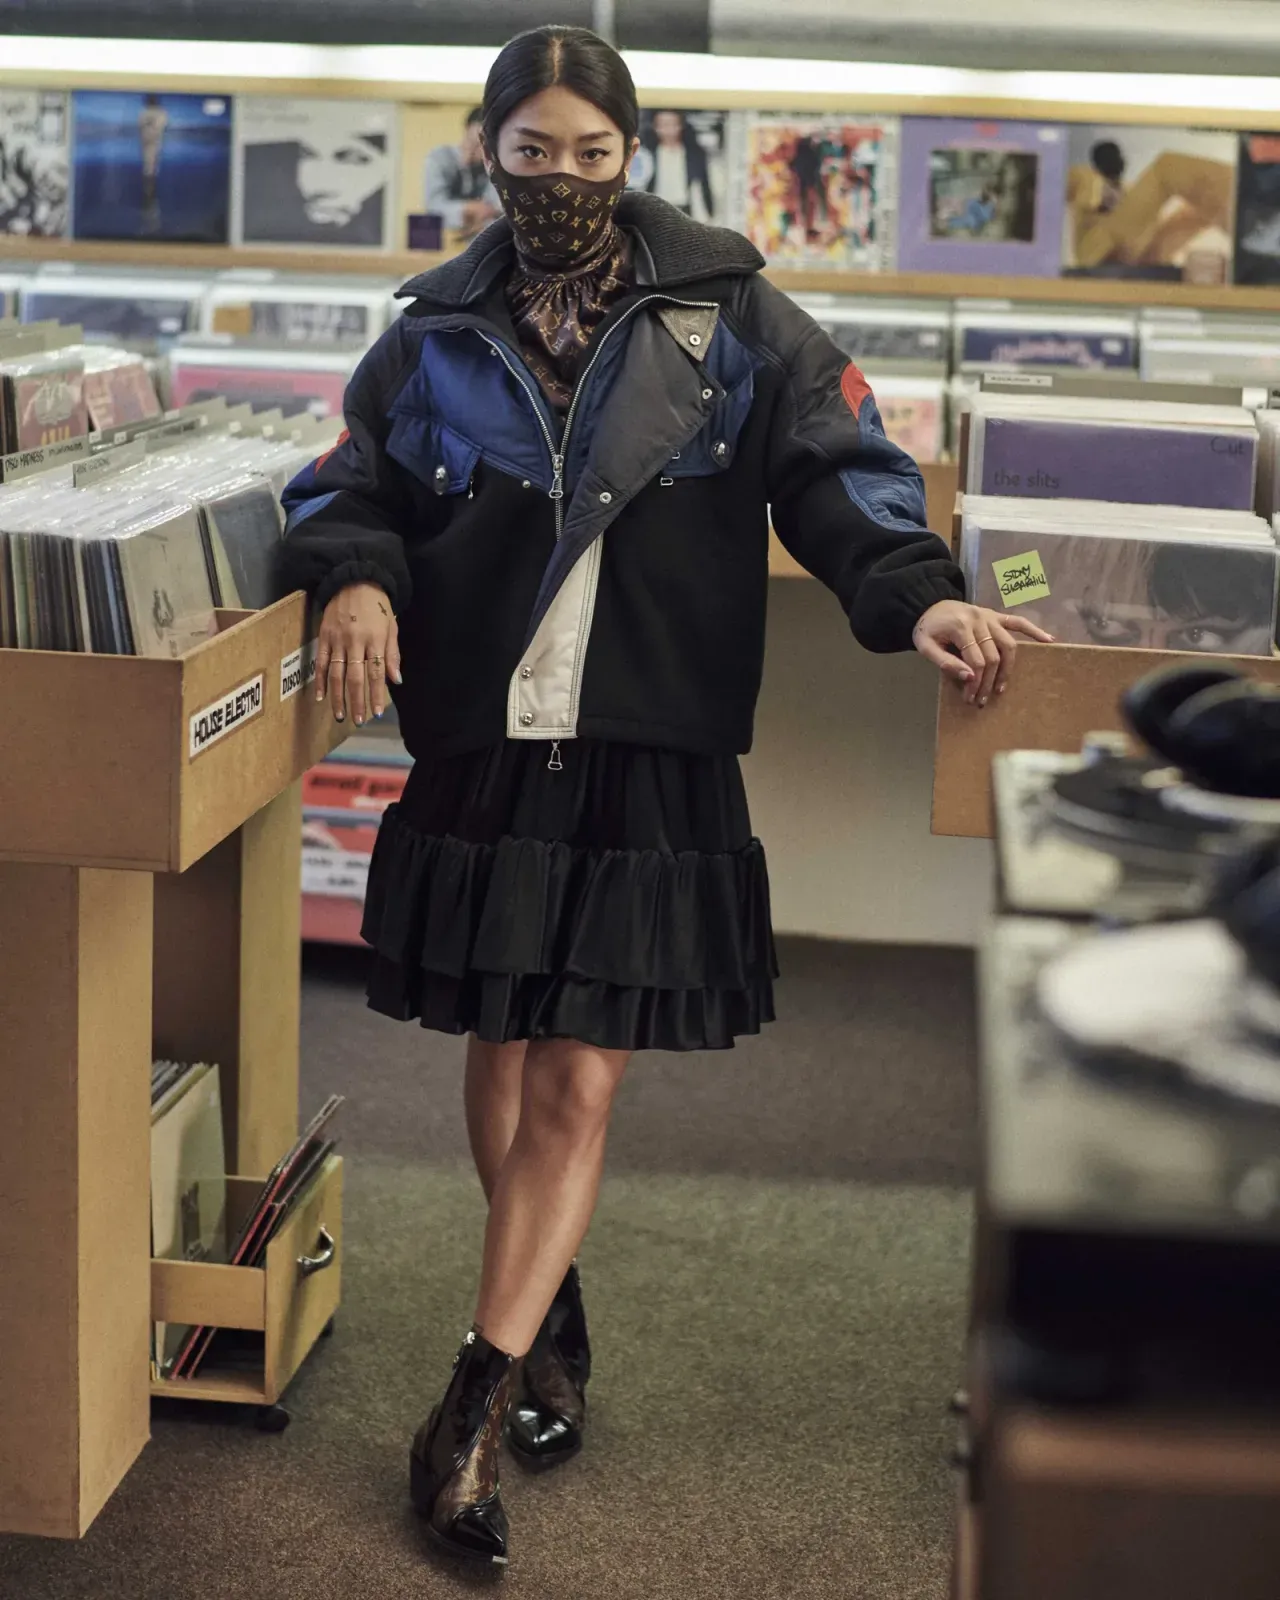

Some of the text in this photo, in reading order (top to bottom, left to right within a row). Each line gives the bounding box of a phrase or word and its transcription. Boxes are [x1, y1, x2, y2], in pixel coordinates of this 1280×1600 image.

[1210, 435, 1246, 457] Cut
[994, 467, 1060, 489] the slits
[282, 669, 301, 695] DISCO
[194, 682, 260, 748] HOUSE ELECTRO
